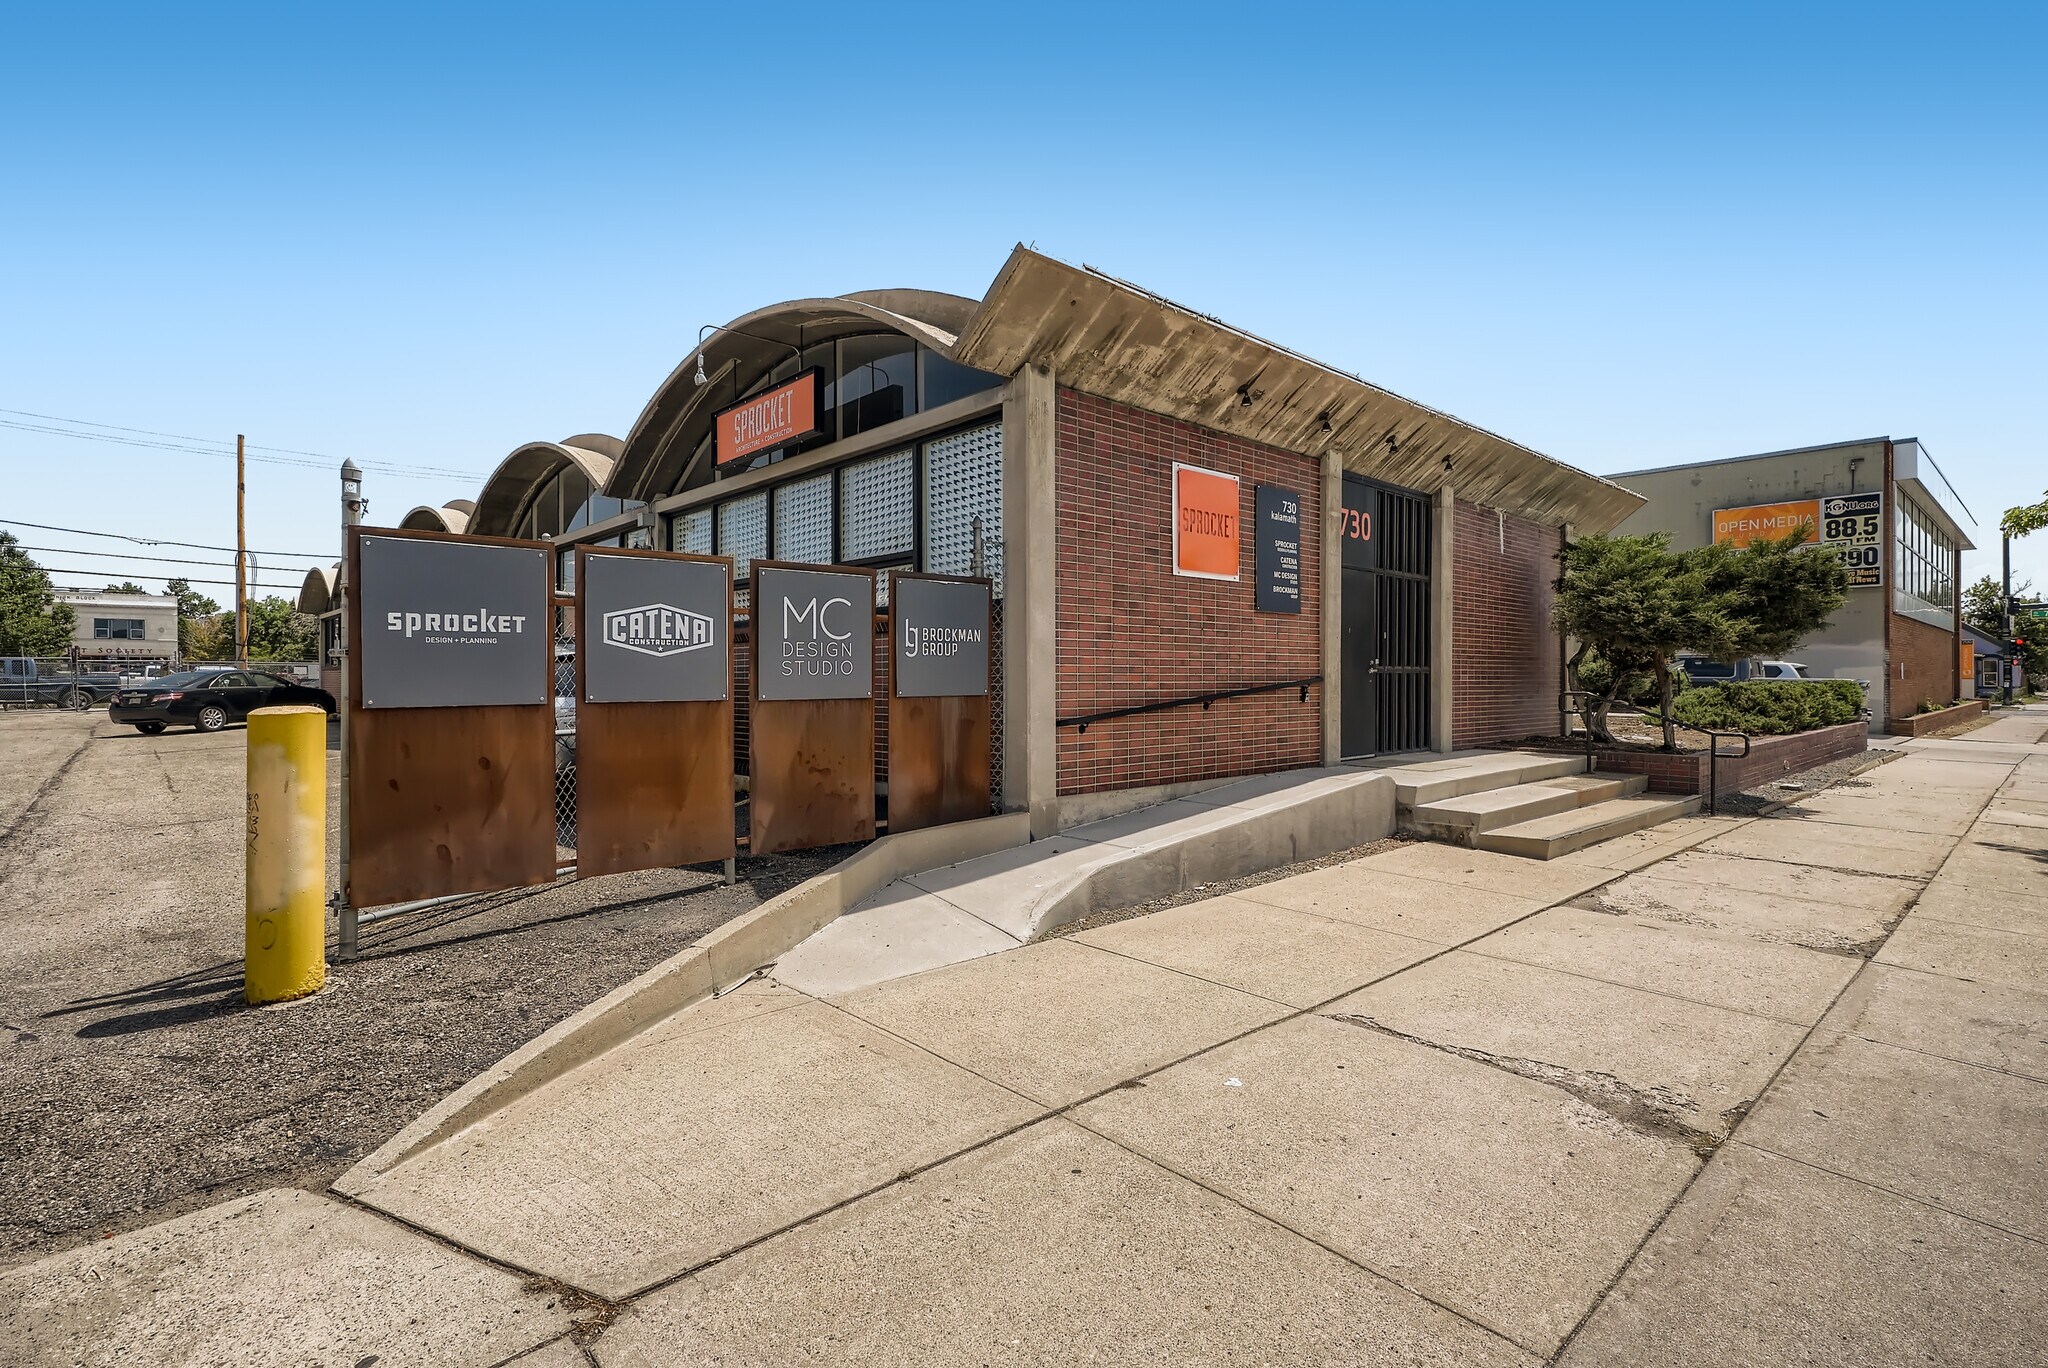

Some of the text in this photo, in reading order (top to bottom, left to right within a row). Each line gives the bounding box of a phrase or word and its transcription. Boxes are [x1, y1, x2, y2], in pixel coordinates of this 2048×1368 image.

[735, 390, 794, 444] SPROCKET
[765, 427, 793, 442] CONSTRUCTION
[1282, 500, 1297, 514] 730
[1183, 507, 1235, 538] SPROCKET
[1271, 510, 1297, 524] kalamath
[1341, 507, 1371, 541] 730
[1719, 514, 1815, 533] OPEN MEDIA
[1826, 516, 1879, 539] 88.5
[1274, 540, 1298, 550] SPROCKET
[1280, 557, 1297, 565] CATENA
[1837, 547, 1878, 568] 390
[1282, 572, 1298, 580] DESIGN
[1273, 585, 1298, 594] BROCKMAN
[783, 596, 852, 640] MC
[612, 608, 706, 645] CATENA
[629, 638, 689, 646] CONSTRUCTION
[922, 627, 981, 642] BROCKMAN
[783, 641, 852, 657] DESIGN
[922, 642, 958, 656] GROUP
[781, 660, 854, 676] STUDIO
